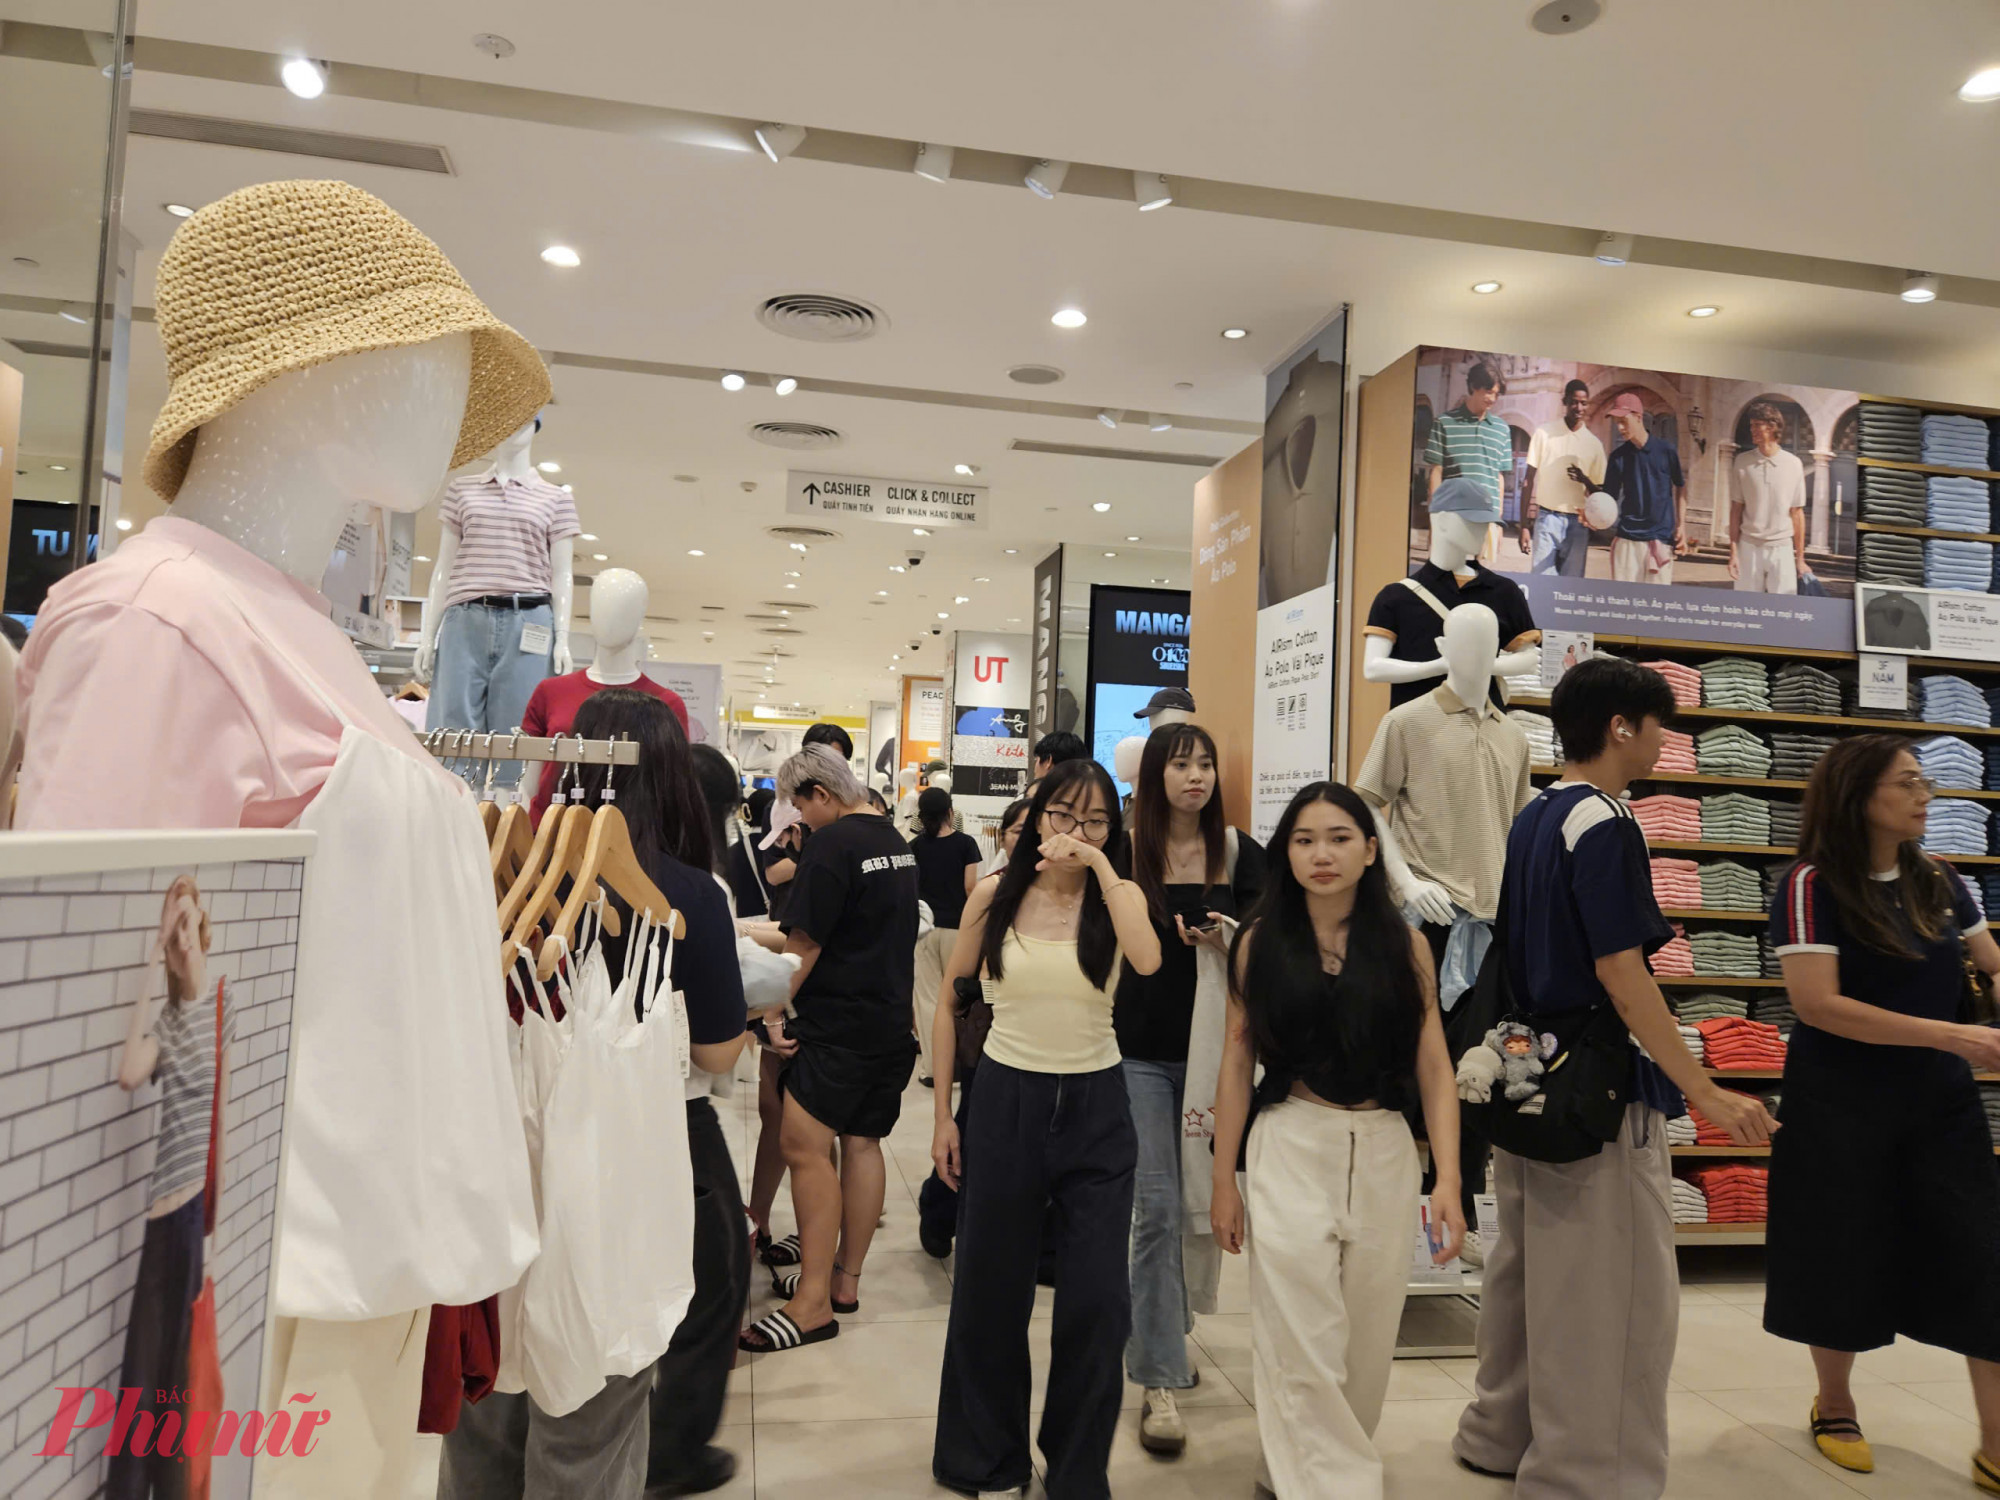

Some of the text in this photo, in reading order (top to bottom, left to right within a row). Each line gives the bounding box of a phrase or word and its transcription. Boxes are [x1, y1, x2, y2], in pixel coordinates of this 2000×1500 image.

[823, 481, 871, 497] CASHIER
[887, 486, 976, 506] CLICK & COLLECT
[950, 511, 976, 521] ONLINE
[1295, 629, 1318, 647] Cotton
[974, 655, 1009, 683] UT
[1275, 659, 1290, 676] Polo
[1304, 652, 1325, 669] Pique
[1872, 672, 1895, 684] NAM
